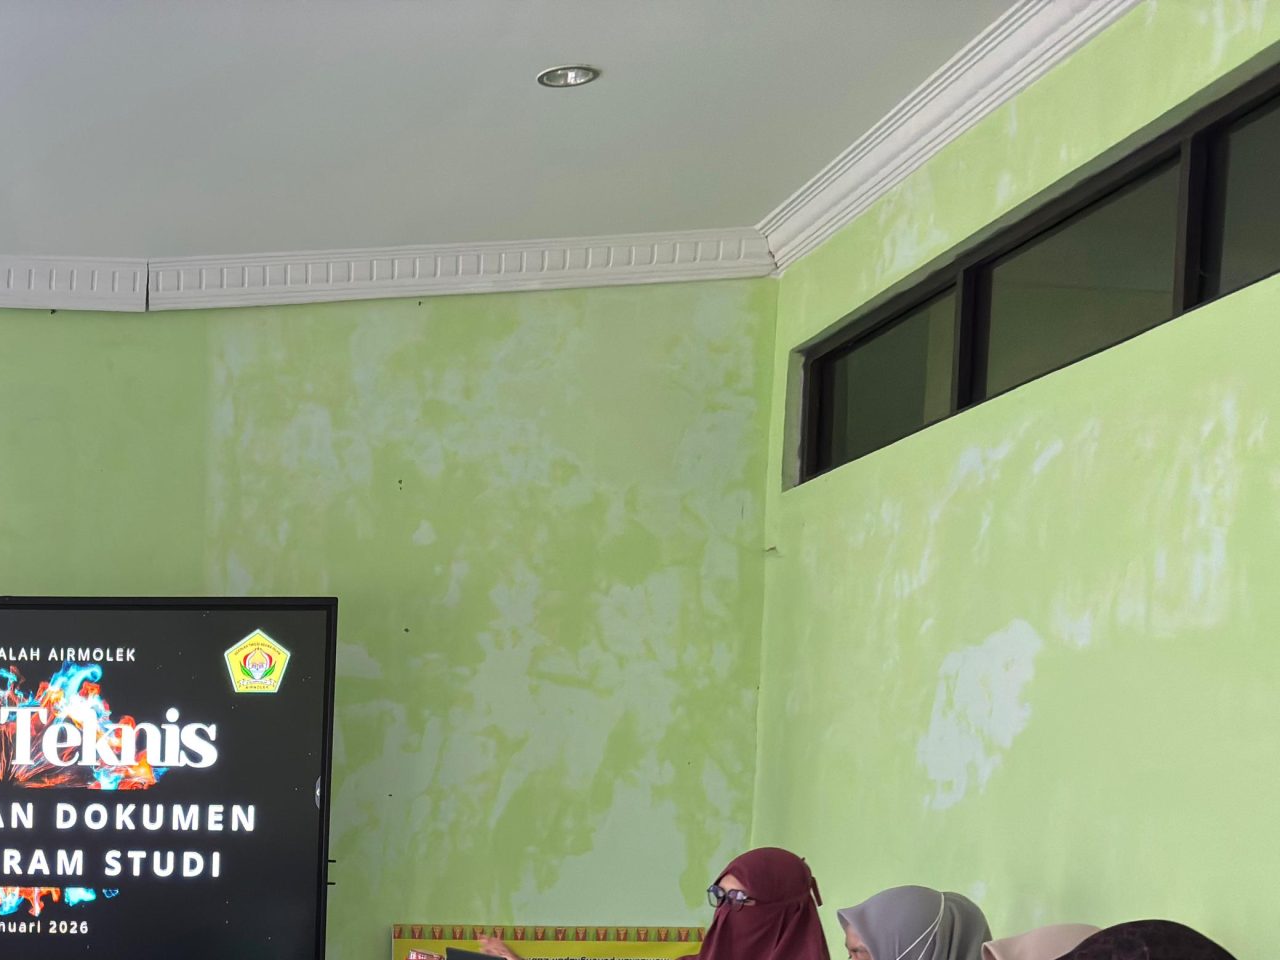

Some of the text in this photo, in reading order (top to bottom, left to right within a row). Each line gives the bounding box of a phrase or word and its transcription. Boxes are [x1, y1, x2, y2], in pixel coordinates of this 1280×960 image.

[48, 647, 136, 662] AIRMOLEK
[0, 704, 218, 769] Teknis
[55, 802, 256, 832] DOKUMEN
[104, 850, 220, 879] STUDI
[48, 920, 89, 934] 2026
